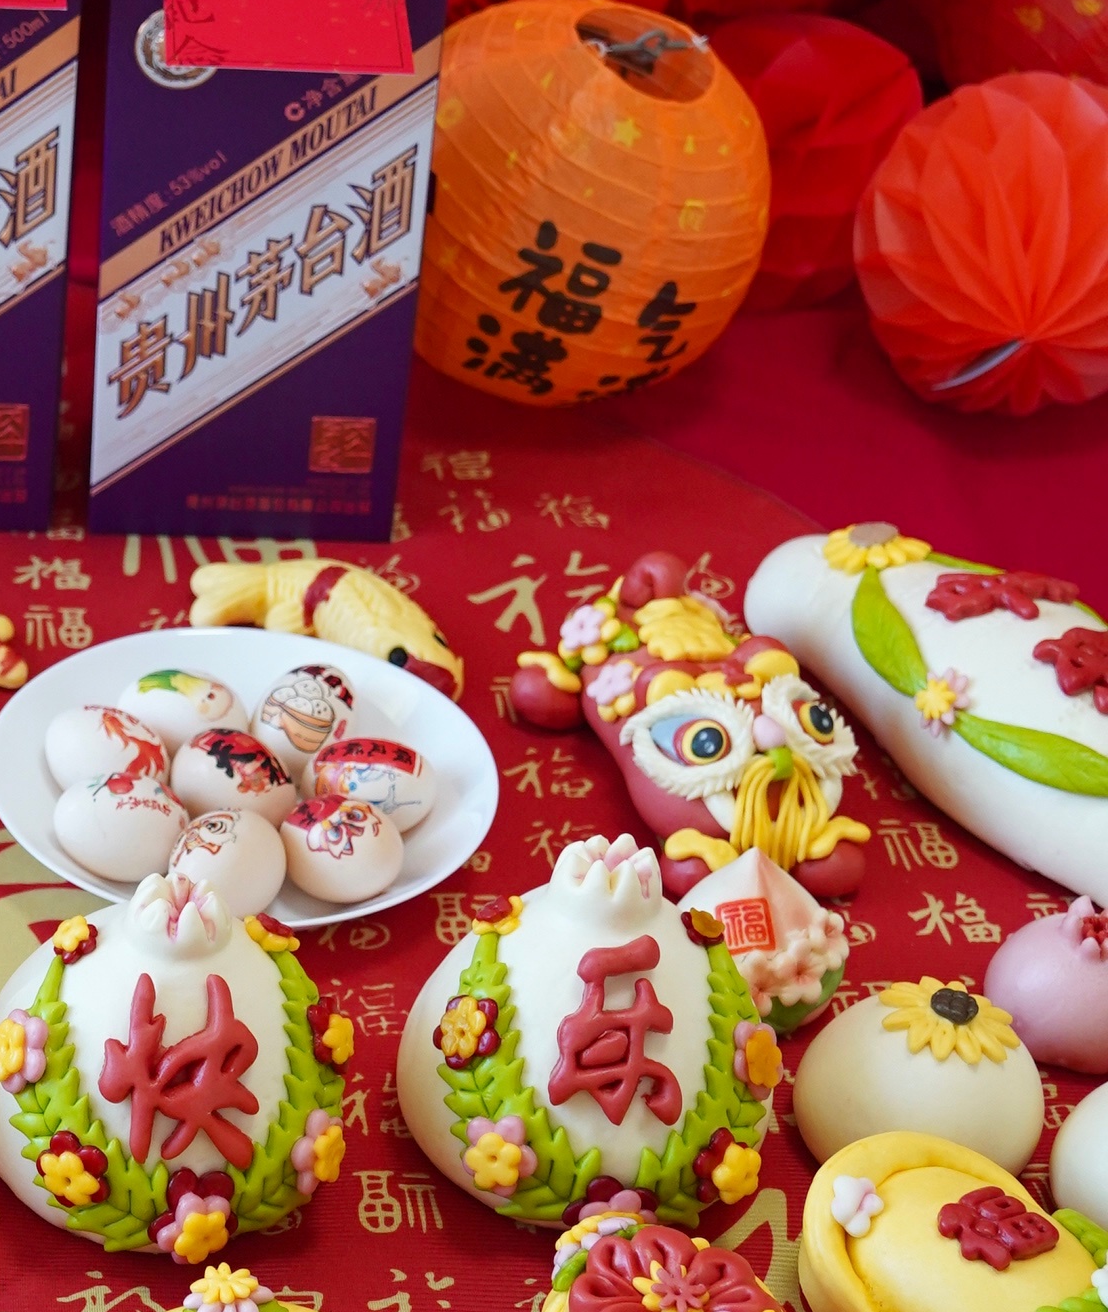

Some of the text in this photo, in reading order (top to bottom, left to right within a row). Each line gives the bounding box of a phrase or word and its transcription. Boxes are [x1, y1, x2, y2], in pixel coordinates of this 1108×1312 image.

[157, 85, 380, 255] KWEICHOW MOUTAI
[108, 143, 420, 421] 贵州茅台酒
[715, 897, 777, 955] 福
[908, 890, 1002, 946] 福
[98, 972, 260, 1171] 快
[548, 934, 683, 1126] 乐
